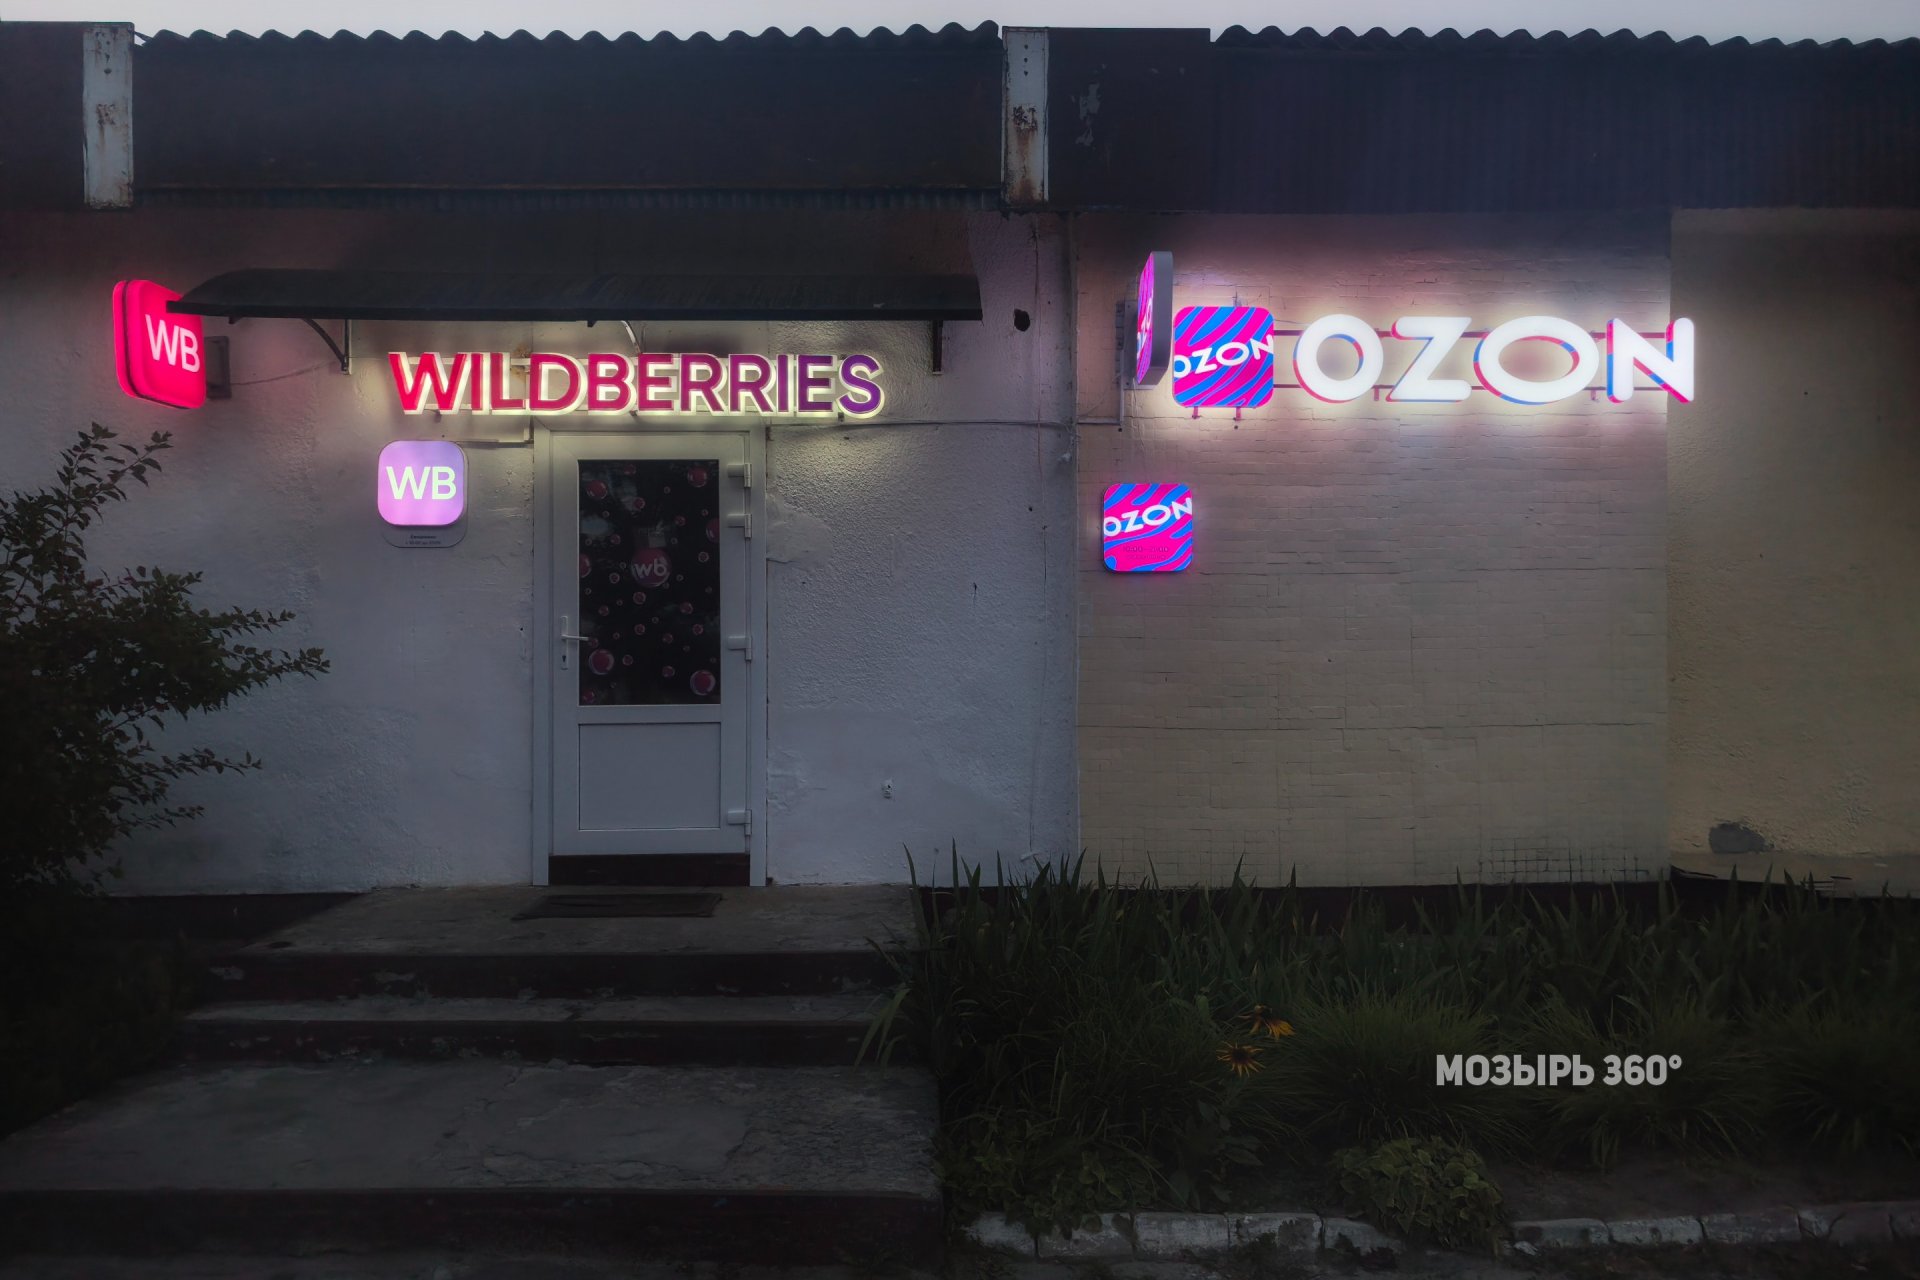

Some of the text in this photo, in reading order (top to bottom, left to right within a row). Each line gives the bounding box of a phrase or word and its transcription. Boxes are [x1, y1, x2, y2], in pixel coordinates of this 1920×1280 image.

[145, 314, 200, 373] WB
[1293, 314, 1695, 405] OZON
[389, 352, 884, 418] WILDBERRIES
[386, 466, 457, 500] WB
